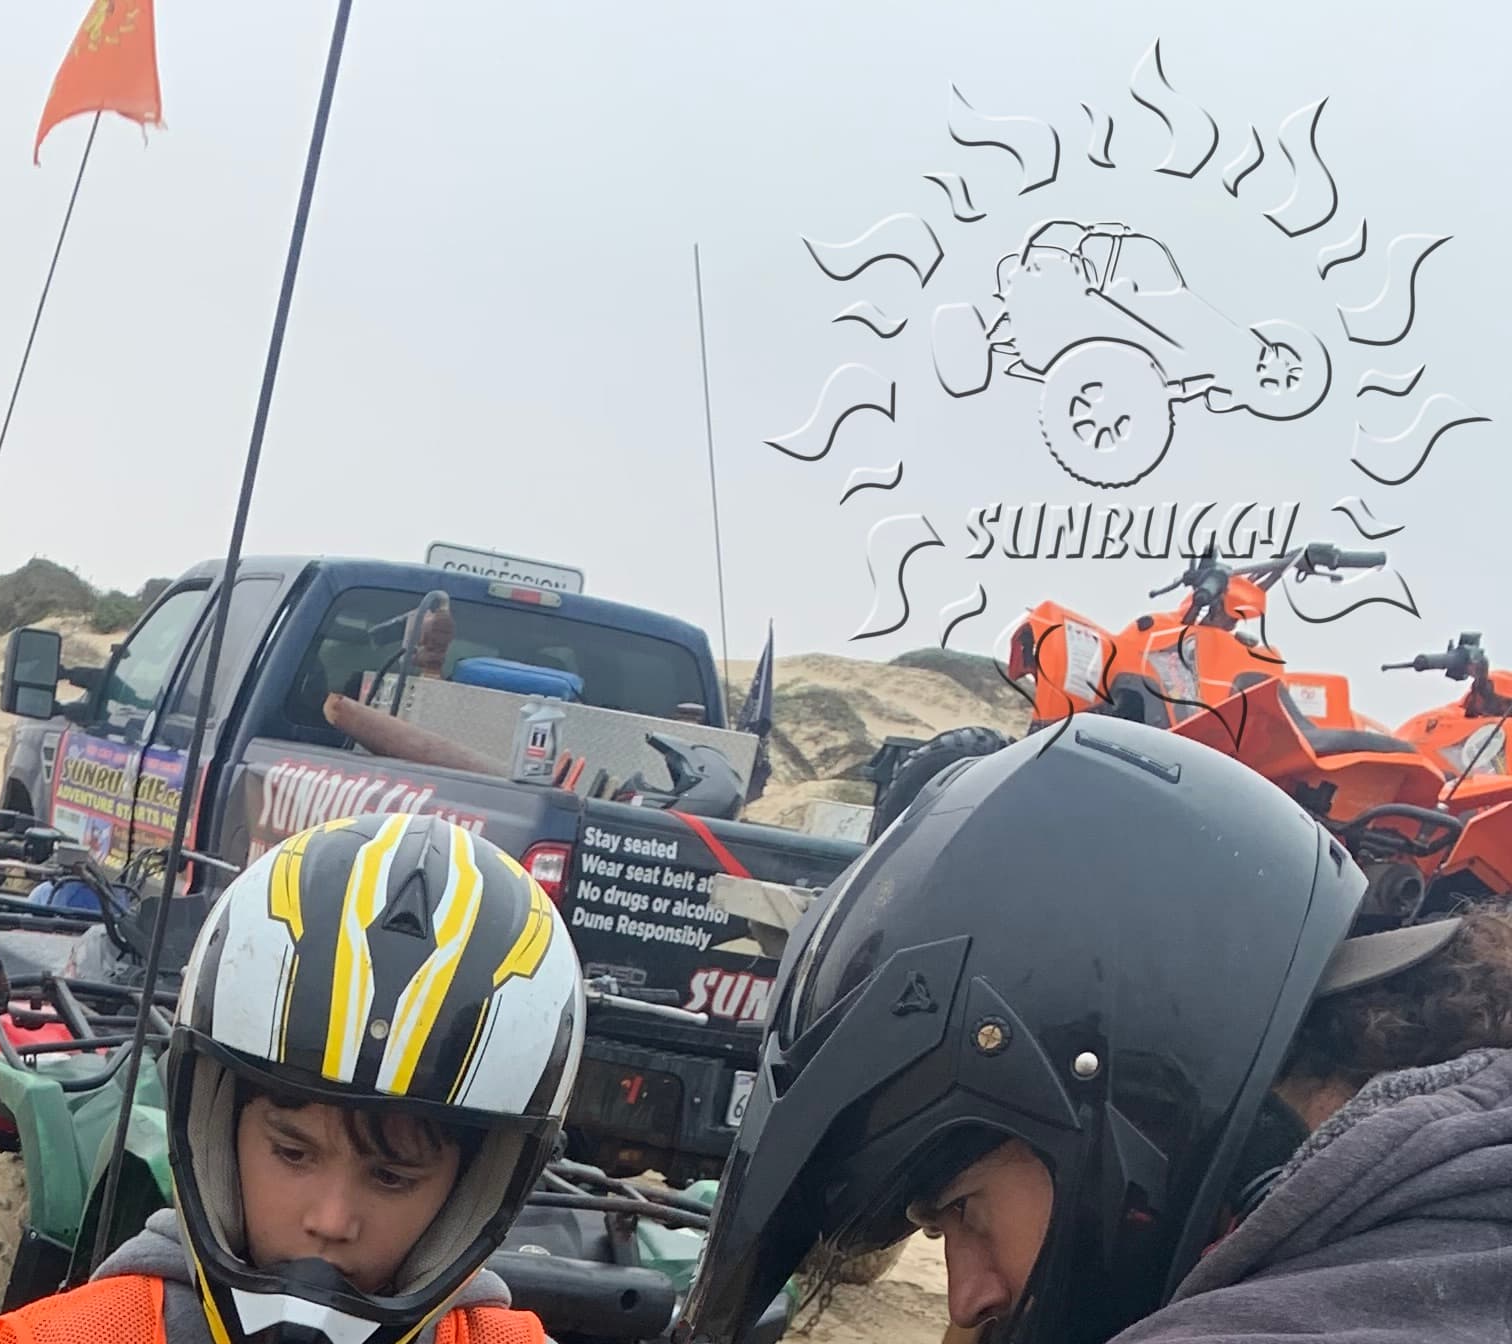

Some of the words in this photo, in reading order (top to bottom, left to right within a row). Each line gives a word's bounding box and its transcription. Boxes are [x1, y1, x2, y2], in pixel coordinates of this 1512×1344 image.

[584, 826, 621, 853] Stay
[623, 837, 678, 860] seated
[581, 853, 625, 878] Wear
[624, 863, 659, 885] seat
[662, 867, 694, 892] belt
[576, 879, 600, 902] No
[603, 885, 649, 912] drugs
[652, 898, 670, 914] or
[571, 906, 615, 931] Dune
[615, 914, 712, 952] Responsibly
